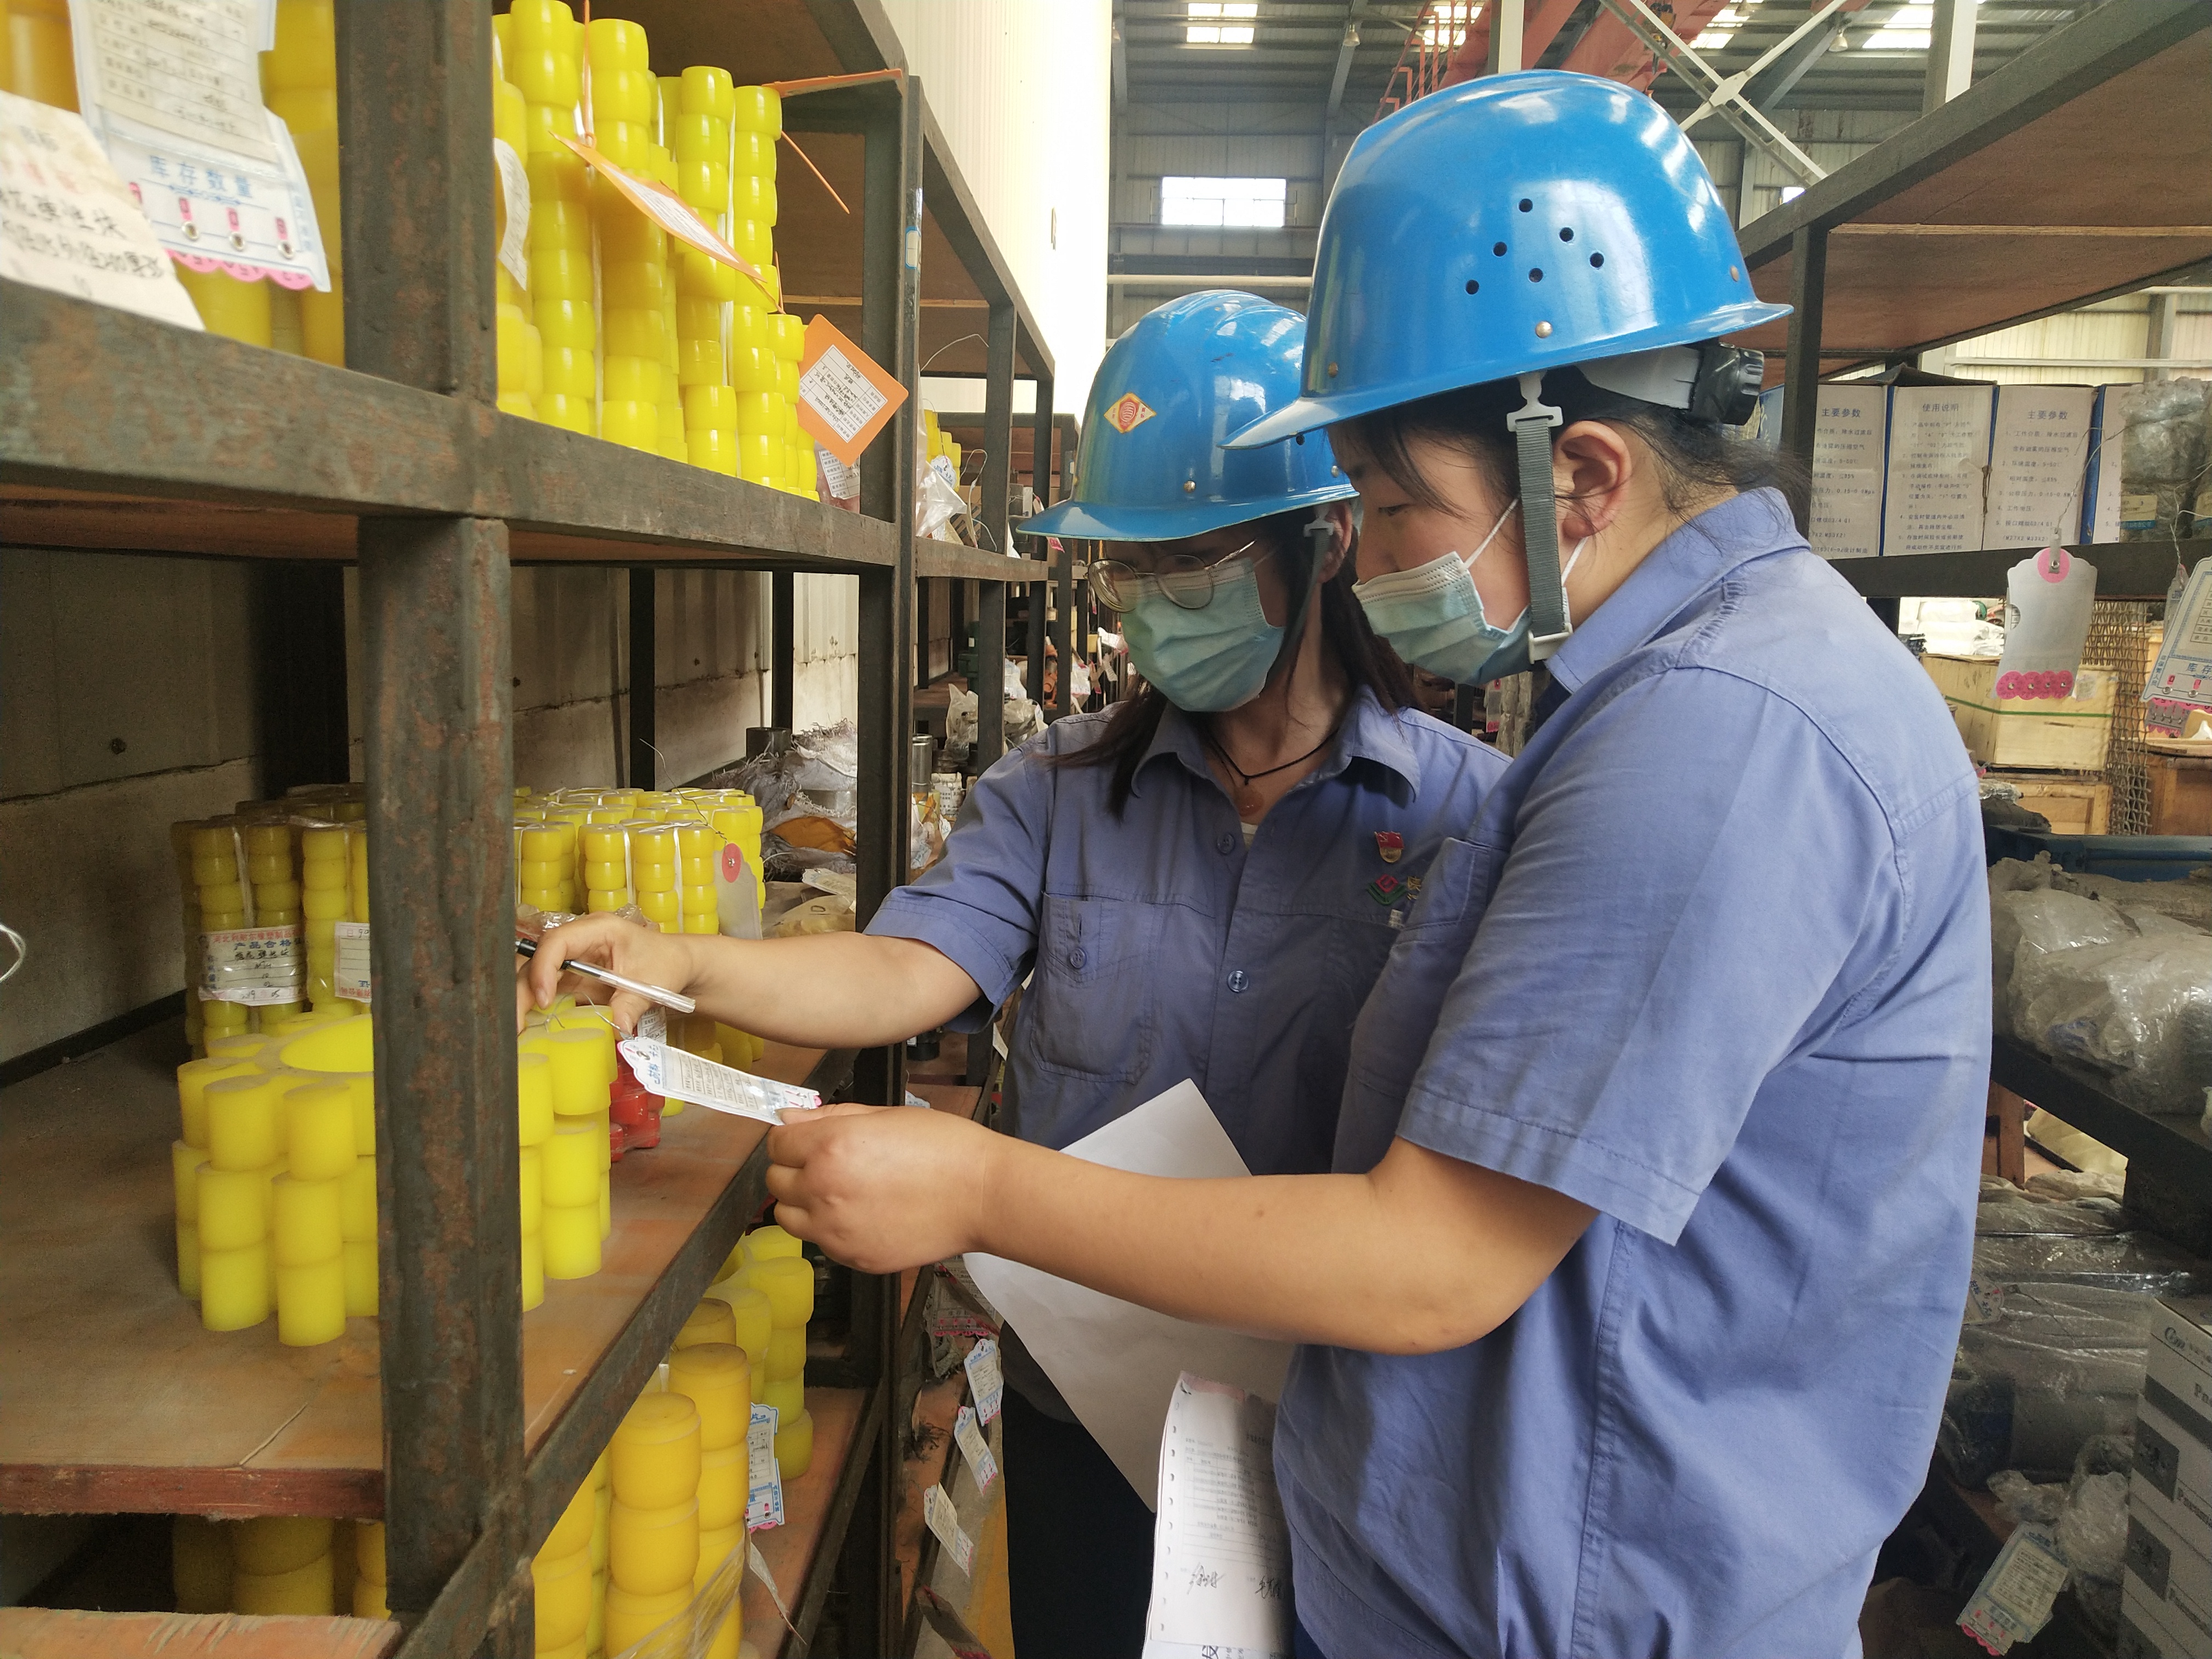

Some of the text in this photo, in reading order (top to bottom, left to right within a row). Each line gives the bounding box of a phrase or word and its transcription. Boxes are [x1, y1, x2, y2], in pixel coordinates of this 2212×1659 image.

[150, 155, 252, 198] 库存数量
[1821, 407, 1860, 418] 主要参数
[1922, 403, 1959, 411] 使用说明
[2027, 410, 2068, 420] 主要参数
[2186, 663, 2212, 675] 库存
